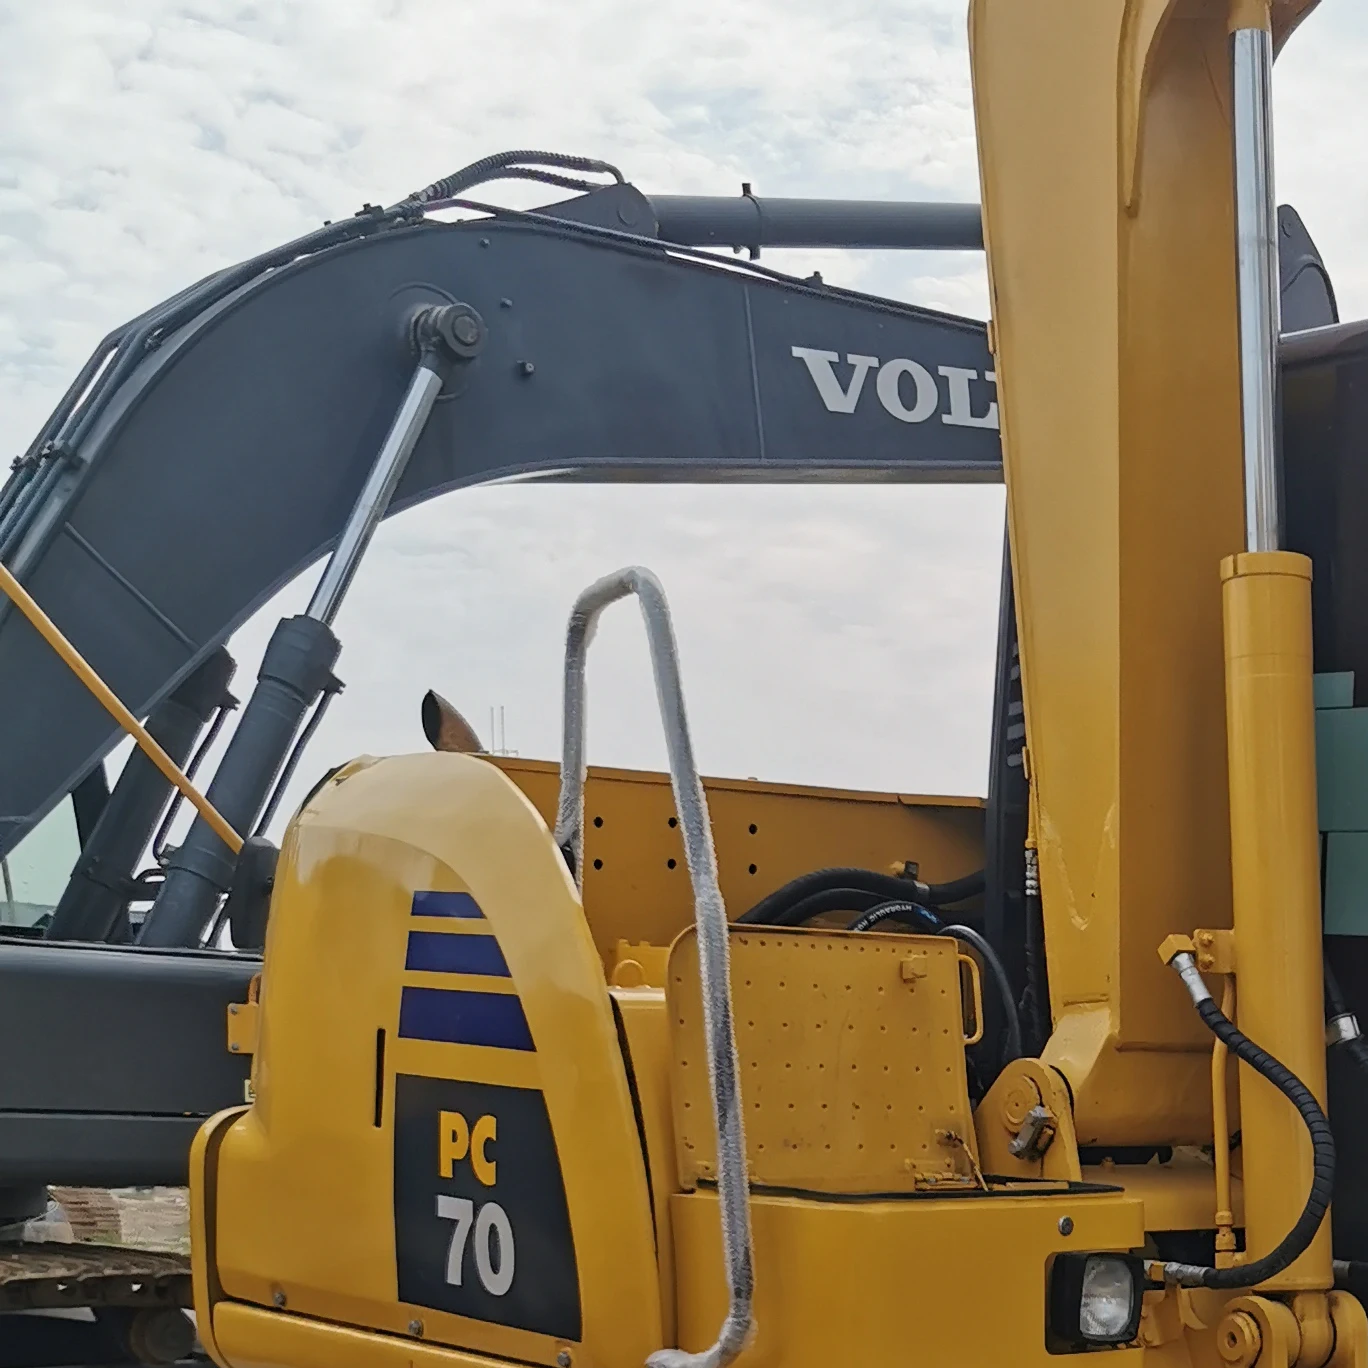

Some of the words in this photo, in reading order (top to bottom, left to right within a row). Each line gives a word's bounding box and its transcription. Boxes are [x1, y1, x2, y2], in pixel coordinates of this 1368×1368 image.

[791, 346, 1000, 429] VOL
[868, 905, 912, 922] HYDRAULIC
[439, 1110, 497, 1186] PC
[436, 1194, 515, 1296] 70
